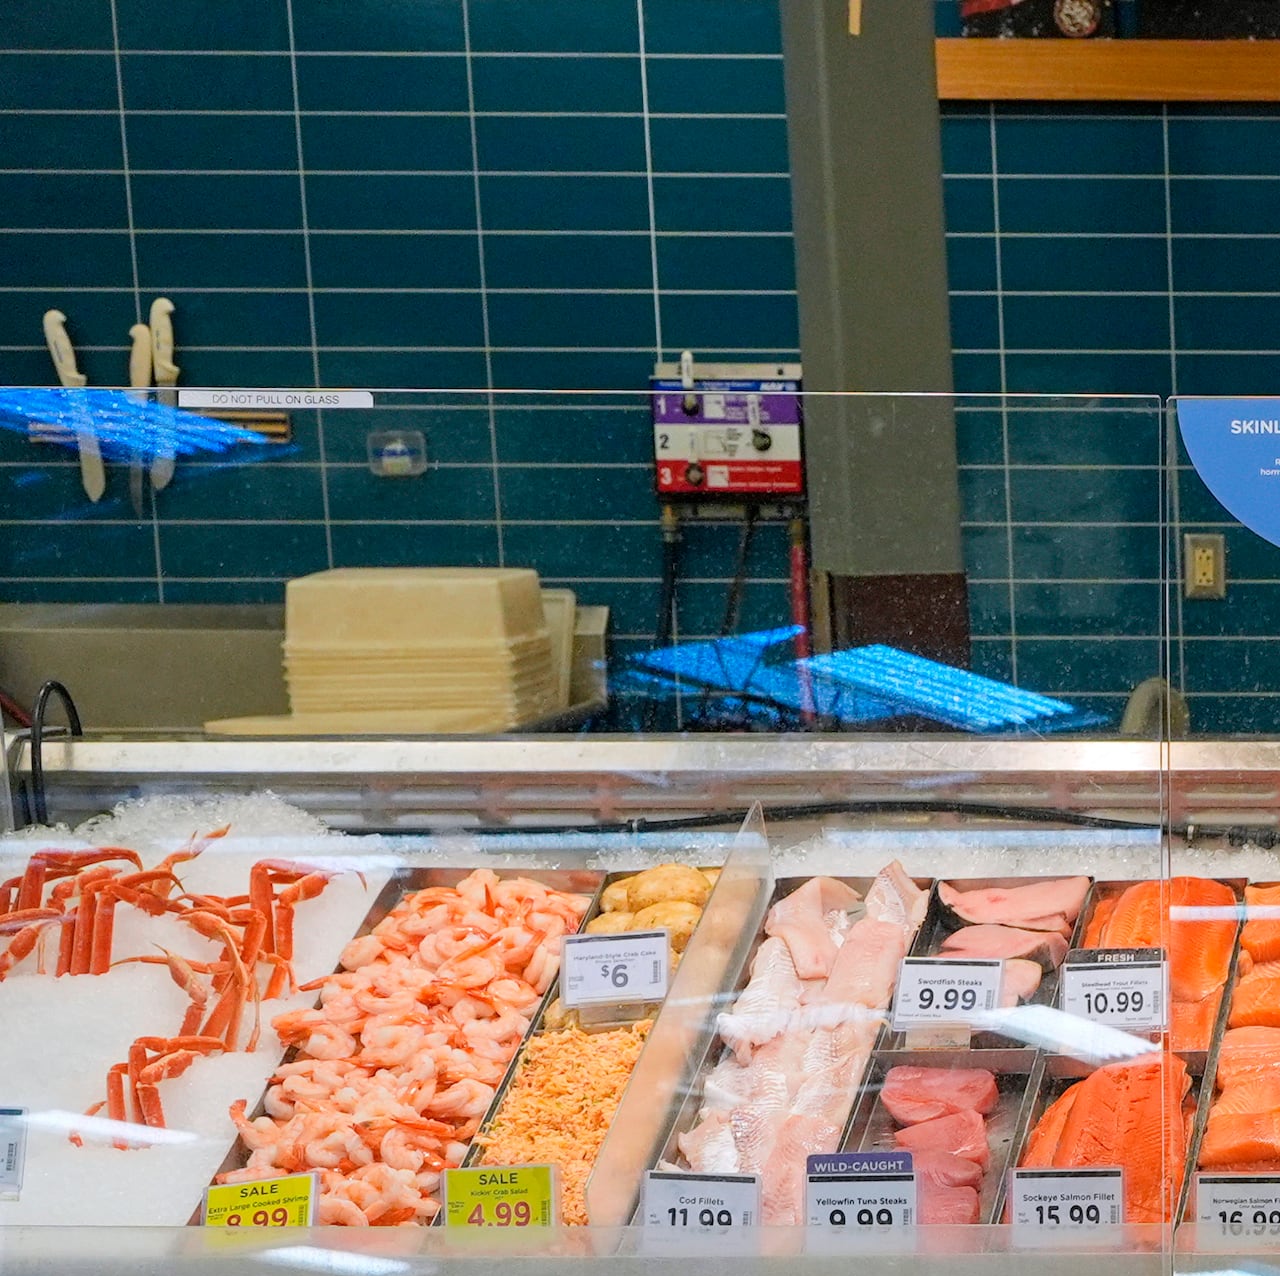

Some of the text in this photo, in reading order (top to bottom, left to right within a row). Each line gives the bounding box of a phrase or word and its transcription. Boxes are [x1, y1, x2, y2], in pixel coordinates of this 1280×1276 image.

[212, 395, 340, 404] DO NOT PULL ON GLASS
[1097, 953, 1135, 962] FRESH
[601, 964, 629, 988] $6
[918, 988, 977, 1010] 9.99
[1084, 991, 1144, 1014] 10.99
[814, 1160, 904, 1172] WILD-CAUGHT
[479, 1172, 518, 1185] SALE
[240, 1184, 279, 1198] SALE
[1023, 1194, 1058, 1202] Sockeye
[1094, 1193, 1115, 1201] Fillet
[208, 1195, 309, 1214] Extra Large Cooked Shrimp
[679, 1196, 724, 1205] Cod Fillets
[816, 1198, 855, 1206] Yellowfin
[880, 1197, 907, 1205] Steaks
[226, 1207, 288, 1226] 899
[467, 1201, 531, 1226] 4.99
[668, 1207, 733, 1226] 1199
[1036, 1205, 1100, 1225] 1599
